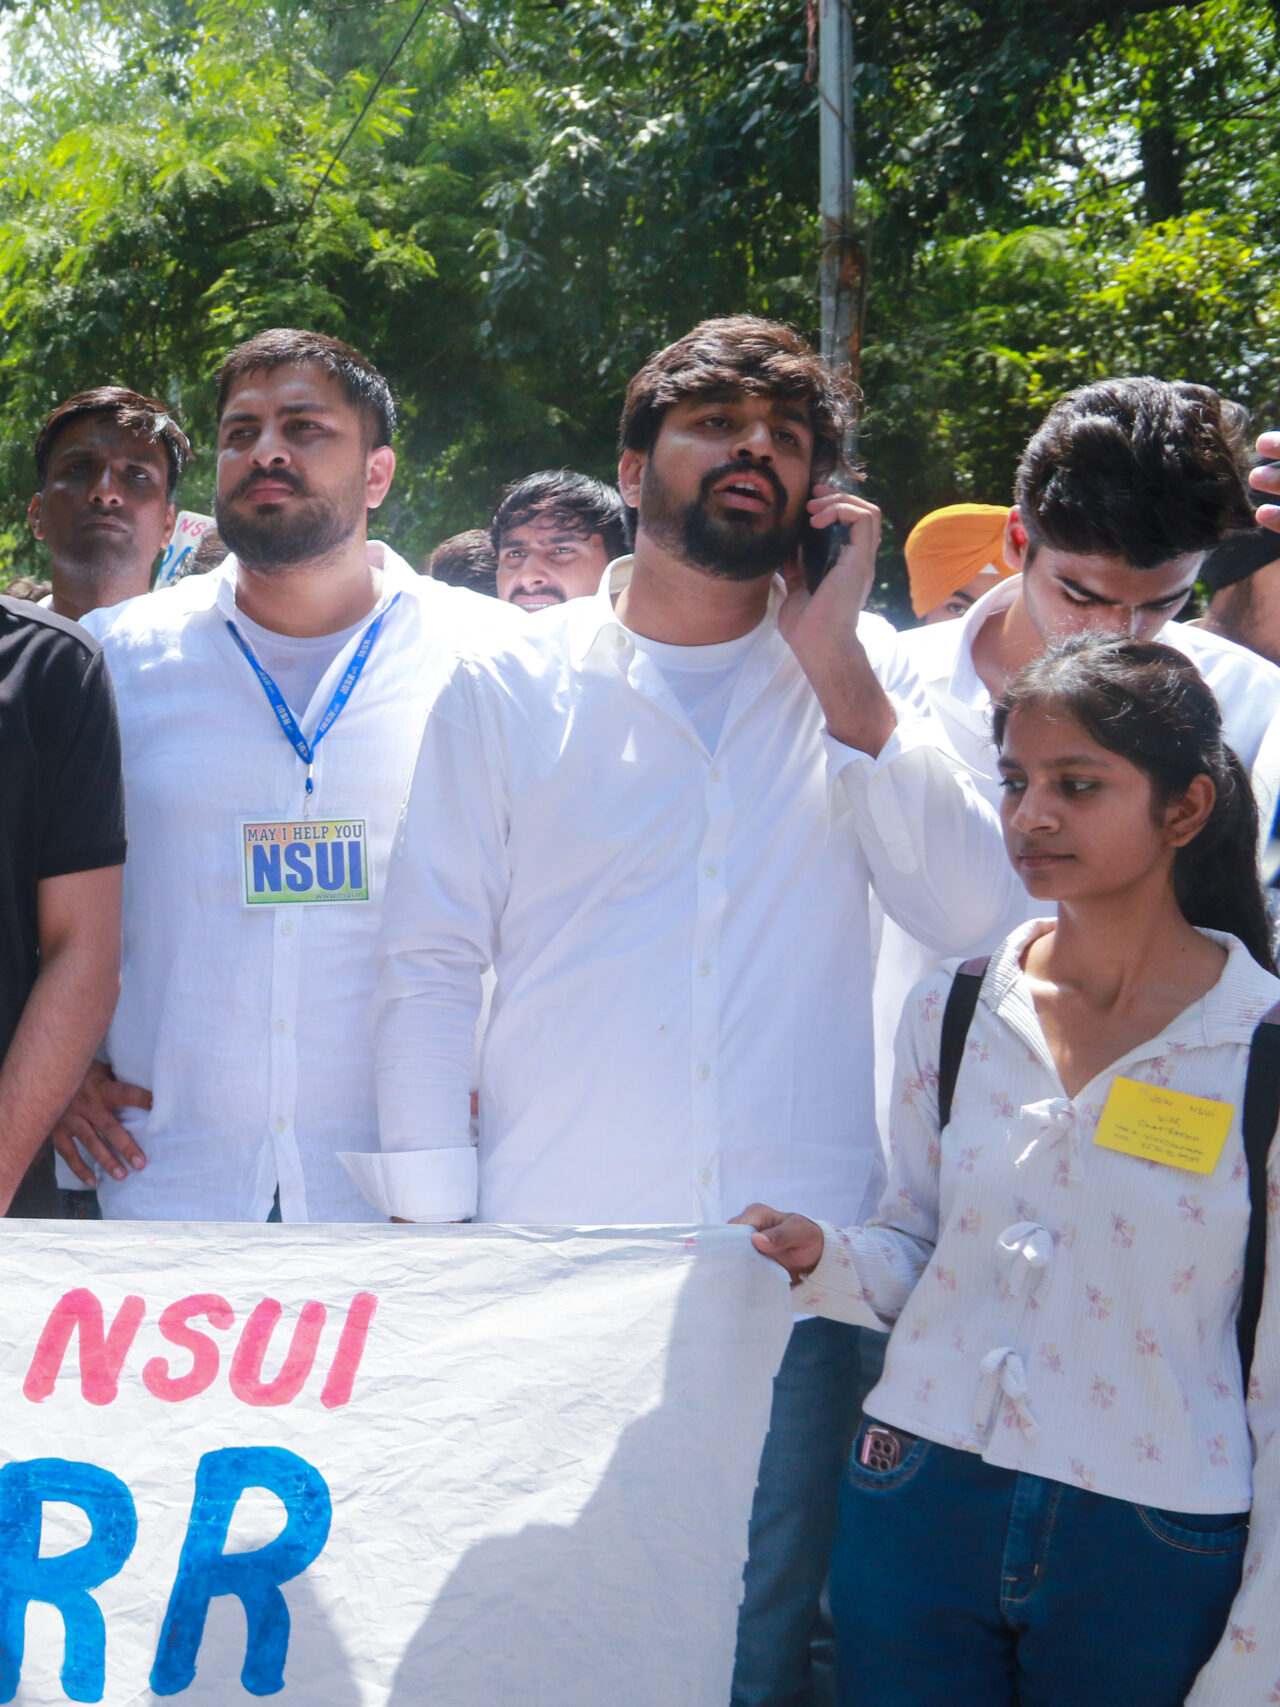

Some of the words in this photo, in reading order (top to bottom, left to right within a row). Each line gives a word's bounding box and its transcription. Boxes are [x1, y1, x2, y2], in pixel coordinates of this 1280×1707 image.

[340, 673, 356, 695] NSUI
[276, 704, 292, 726] NSUI
[248, 828, 277, 841] MAY
[282, 827, 288, 840] I
[293, 826, 329, 840] HELP
[334, 825, 363, 838] YOU
[252, 841, 363, 892] NSUI
[23, 1287, 379, 1409] NSUI
